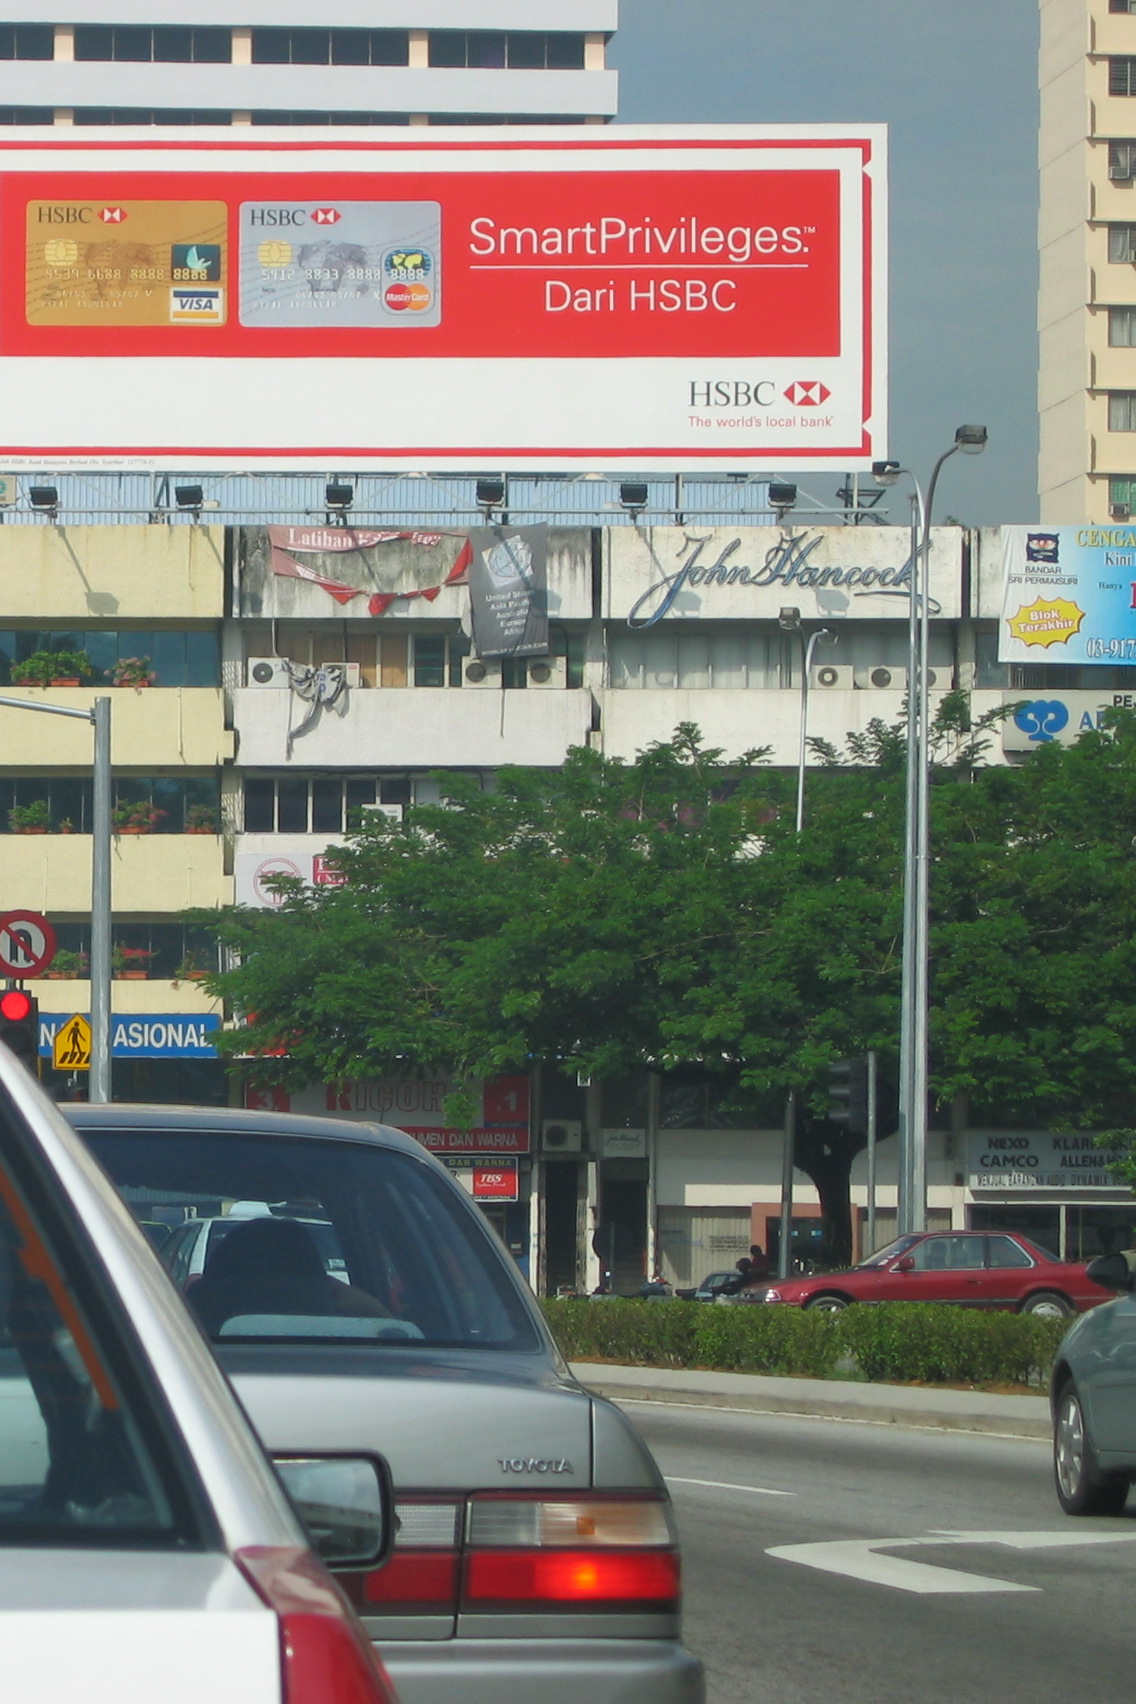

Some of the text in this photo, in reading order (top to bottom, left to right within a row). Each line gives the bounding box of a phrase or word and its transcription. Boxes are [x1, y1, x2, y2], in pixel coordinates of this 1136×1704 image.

[37, 206, 93, 224] HSBC
[250, 208, 306, 226] HSBC
[386, 292, 430, 302] MasterCard
[544, 279, 737, 312] Dari HSBC
[179, 298, 213, 311] VISA
[688, 381, 775, 407] HSBC
[687, 416, 832, 427] The world's local bank
[289, 528, 352, 547] Latihan
[1105, 551, 1131, 566] Kini
[1025, 566, 1062, 574] BANDAR
[627, 532, 940, 629] John Hancock
[1030, 609, 1061, 621] Blok
[1017, 619, 1075, 633] Terakhir
[104, 1022, 212, 1047] ASIONAL
[326, 1081, 447, 1112] RICOH
[449, 1133, 473, 1146] DAN
[476, 1133, 518, 1146] WARNA
[988, 1137, 1030, 1149] NEXO
[980, 1155, 1039, 1167] CAMCO
[497, 1458, 574, 1473] TOYOTA
